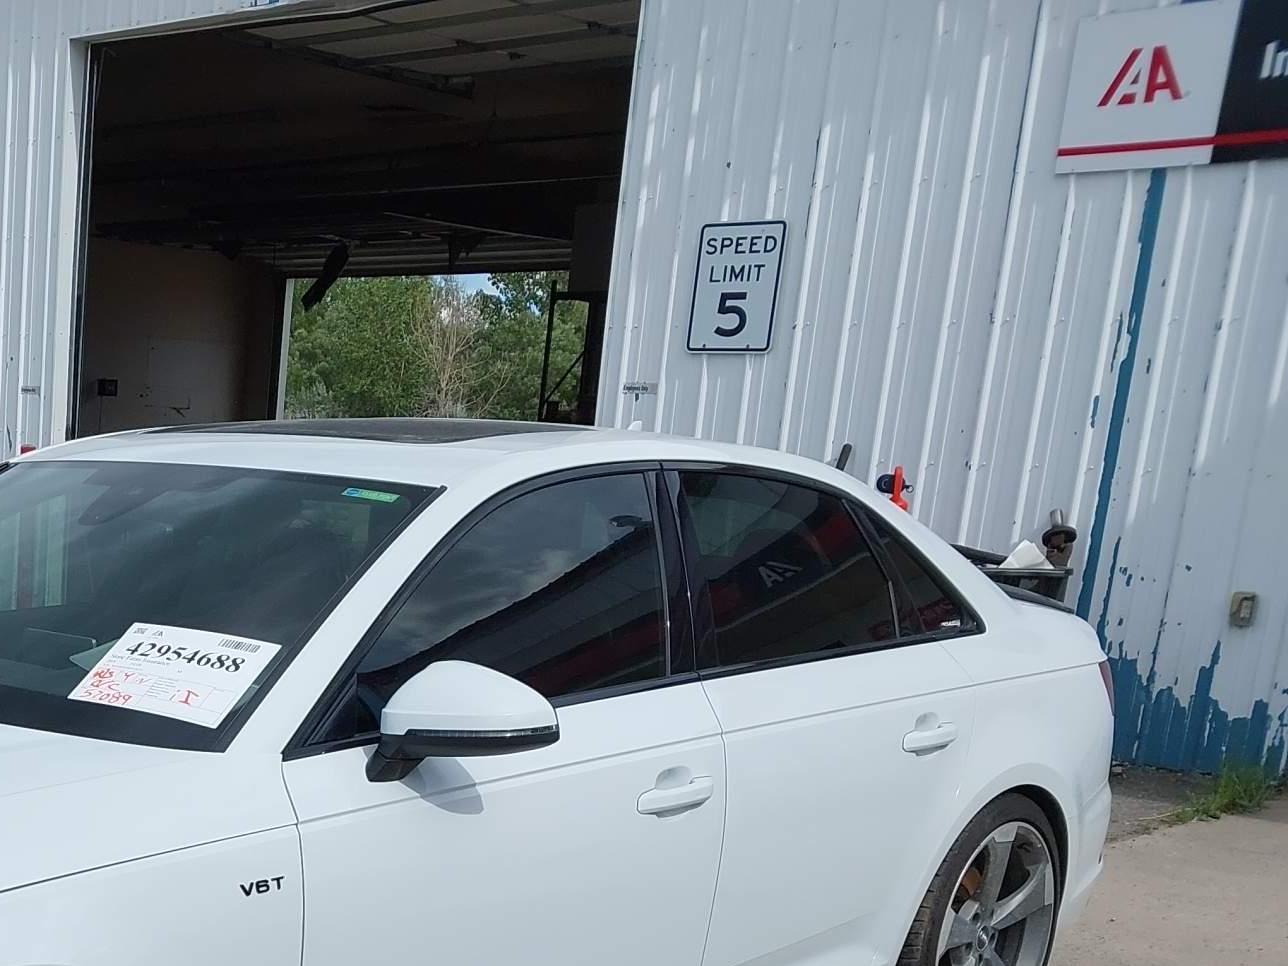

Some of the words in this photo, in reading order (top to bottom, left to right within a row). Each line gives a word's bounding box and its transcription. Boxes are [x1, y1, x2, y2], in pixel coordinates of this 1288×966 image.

[705, 235, 778, 255] SPEED
[709, 264, 766, 283] LIMIT
[713, 291, 748, 338] 5
[125, 641, 246, 673] 42954688
[240, 876, 285, 896] V6T
